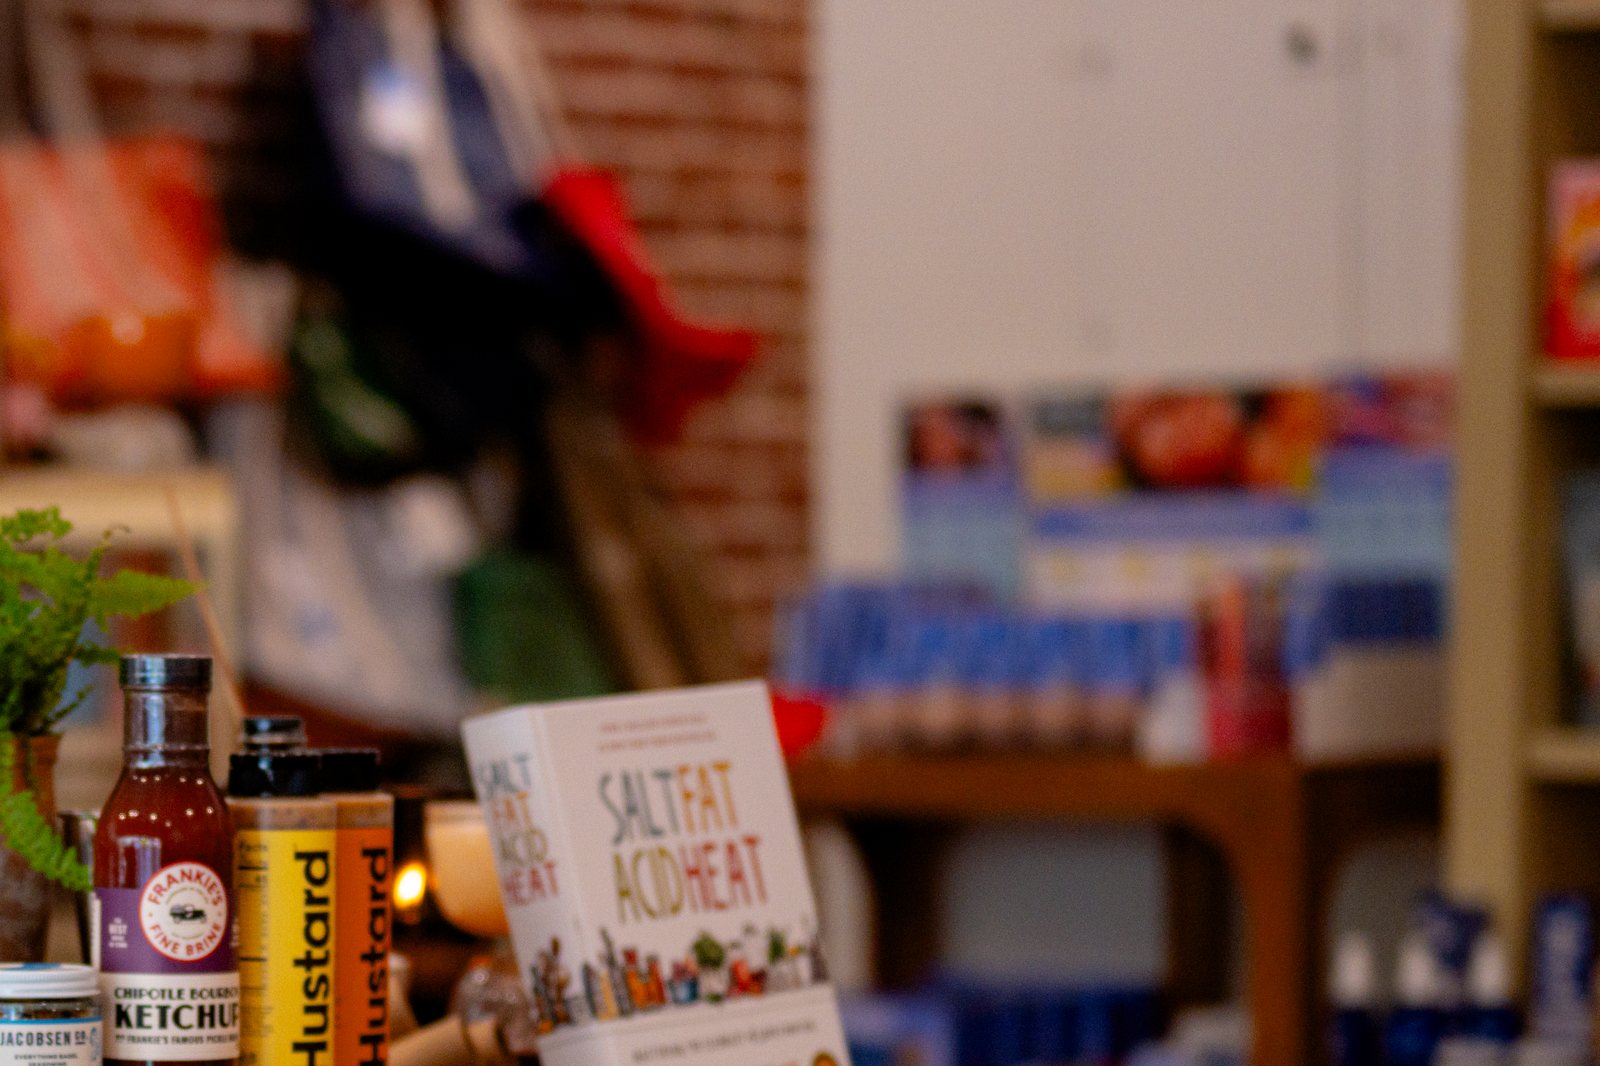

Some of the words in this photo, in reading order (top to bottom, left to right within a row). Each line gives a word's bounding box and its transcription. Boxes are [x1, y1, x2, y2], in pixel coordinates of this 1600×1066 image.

[598, 768, 681, 846] SALT
[677, 761, 738, 833] FAT
[148, 869, 223, 906] FRANKIE'S
[612, 846, 685, 923] ACID
[681, 835, 768, 912] HEAT
[150, 923, 180, 954] FINE
[185, 922, 221, 956] BRINE
[114, 986, 186, 999] CHIPOTLE
[0, 1031, 71, 1046] JACOBSEN
